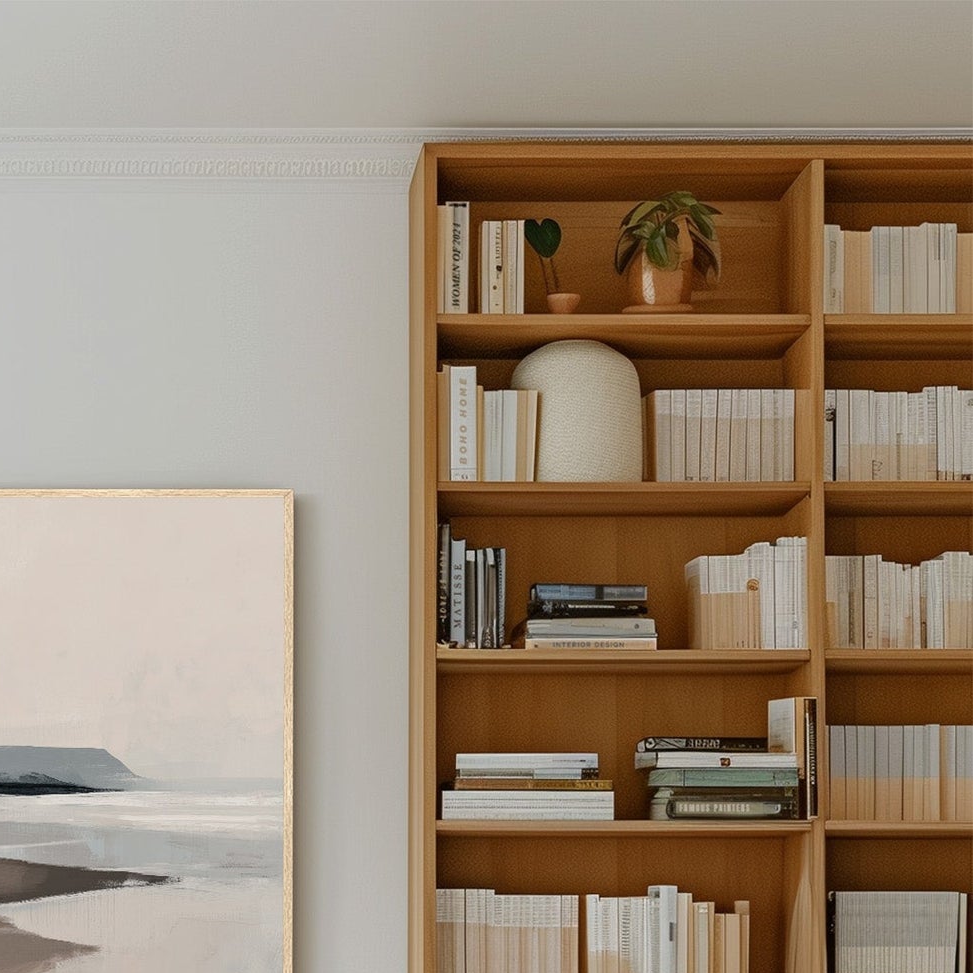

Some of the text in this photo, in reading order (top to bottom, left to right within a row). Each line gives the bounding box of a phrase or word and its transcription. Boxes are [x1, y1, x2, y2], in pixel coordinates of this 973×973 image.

[451, 246, 461, 262] OF
[451, 264, 460, 307] WOMEN
[459, 376, 468, 465] BOHO HOME
[453, 563, 462, 629] MATISSE
[679, 803, 750, 812] FAMOUS PAINTERS
